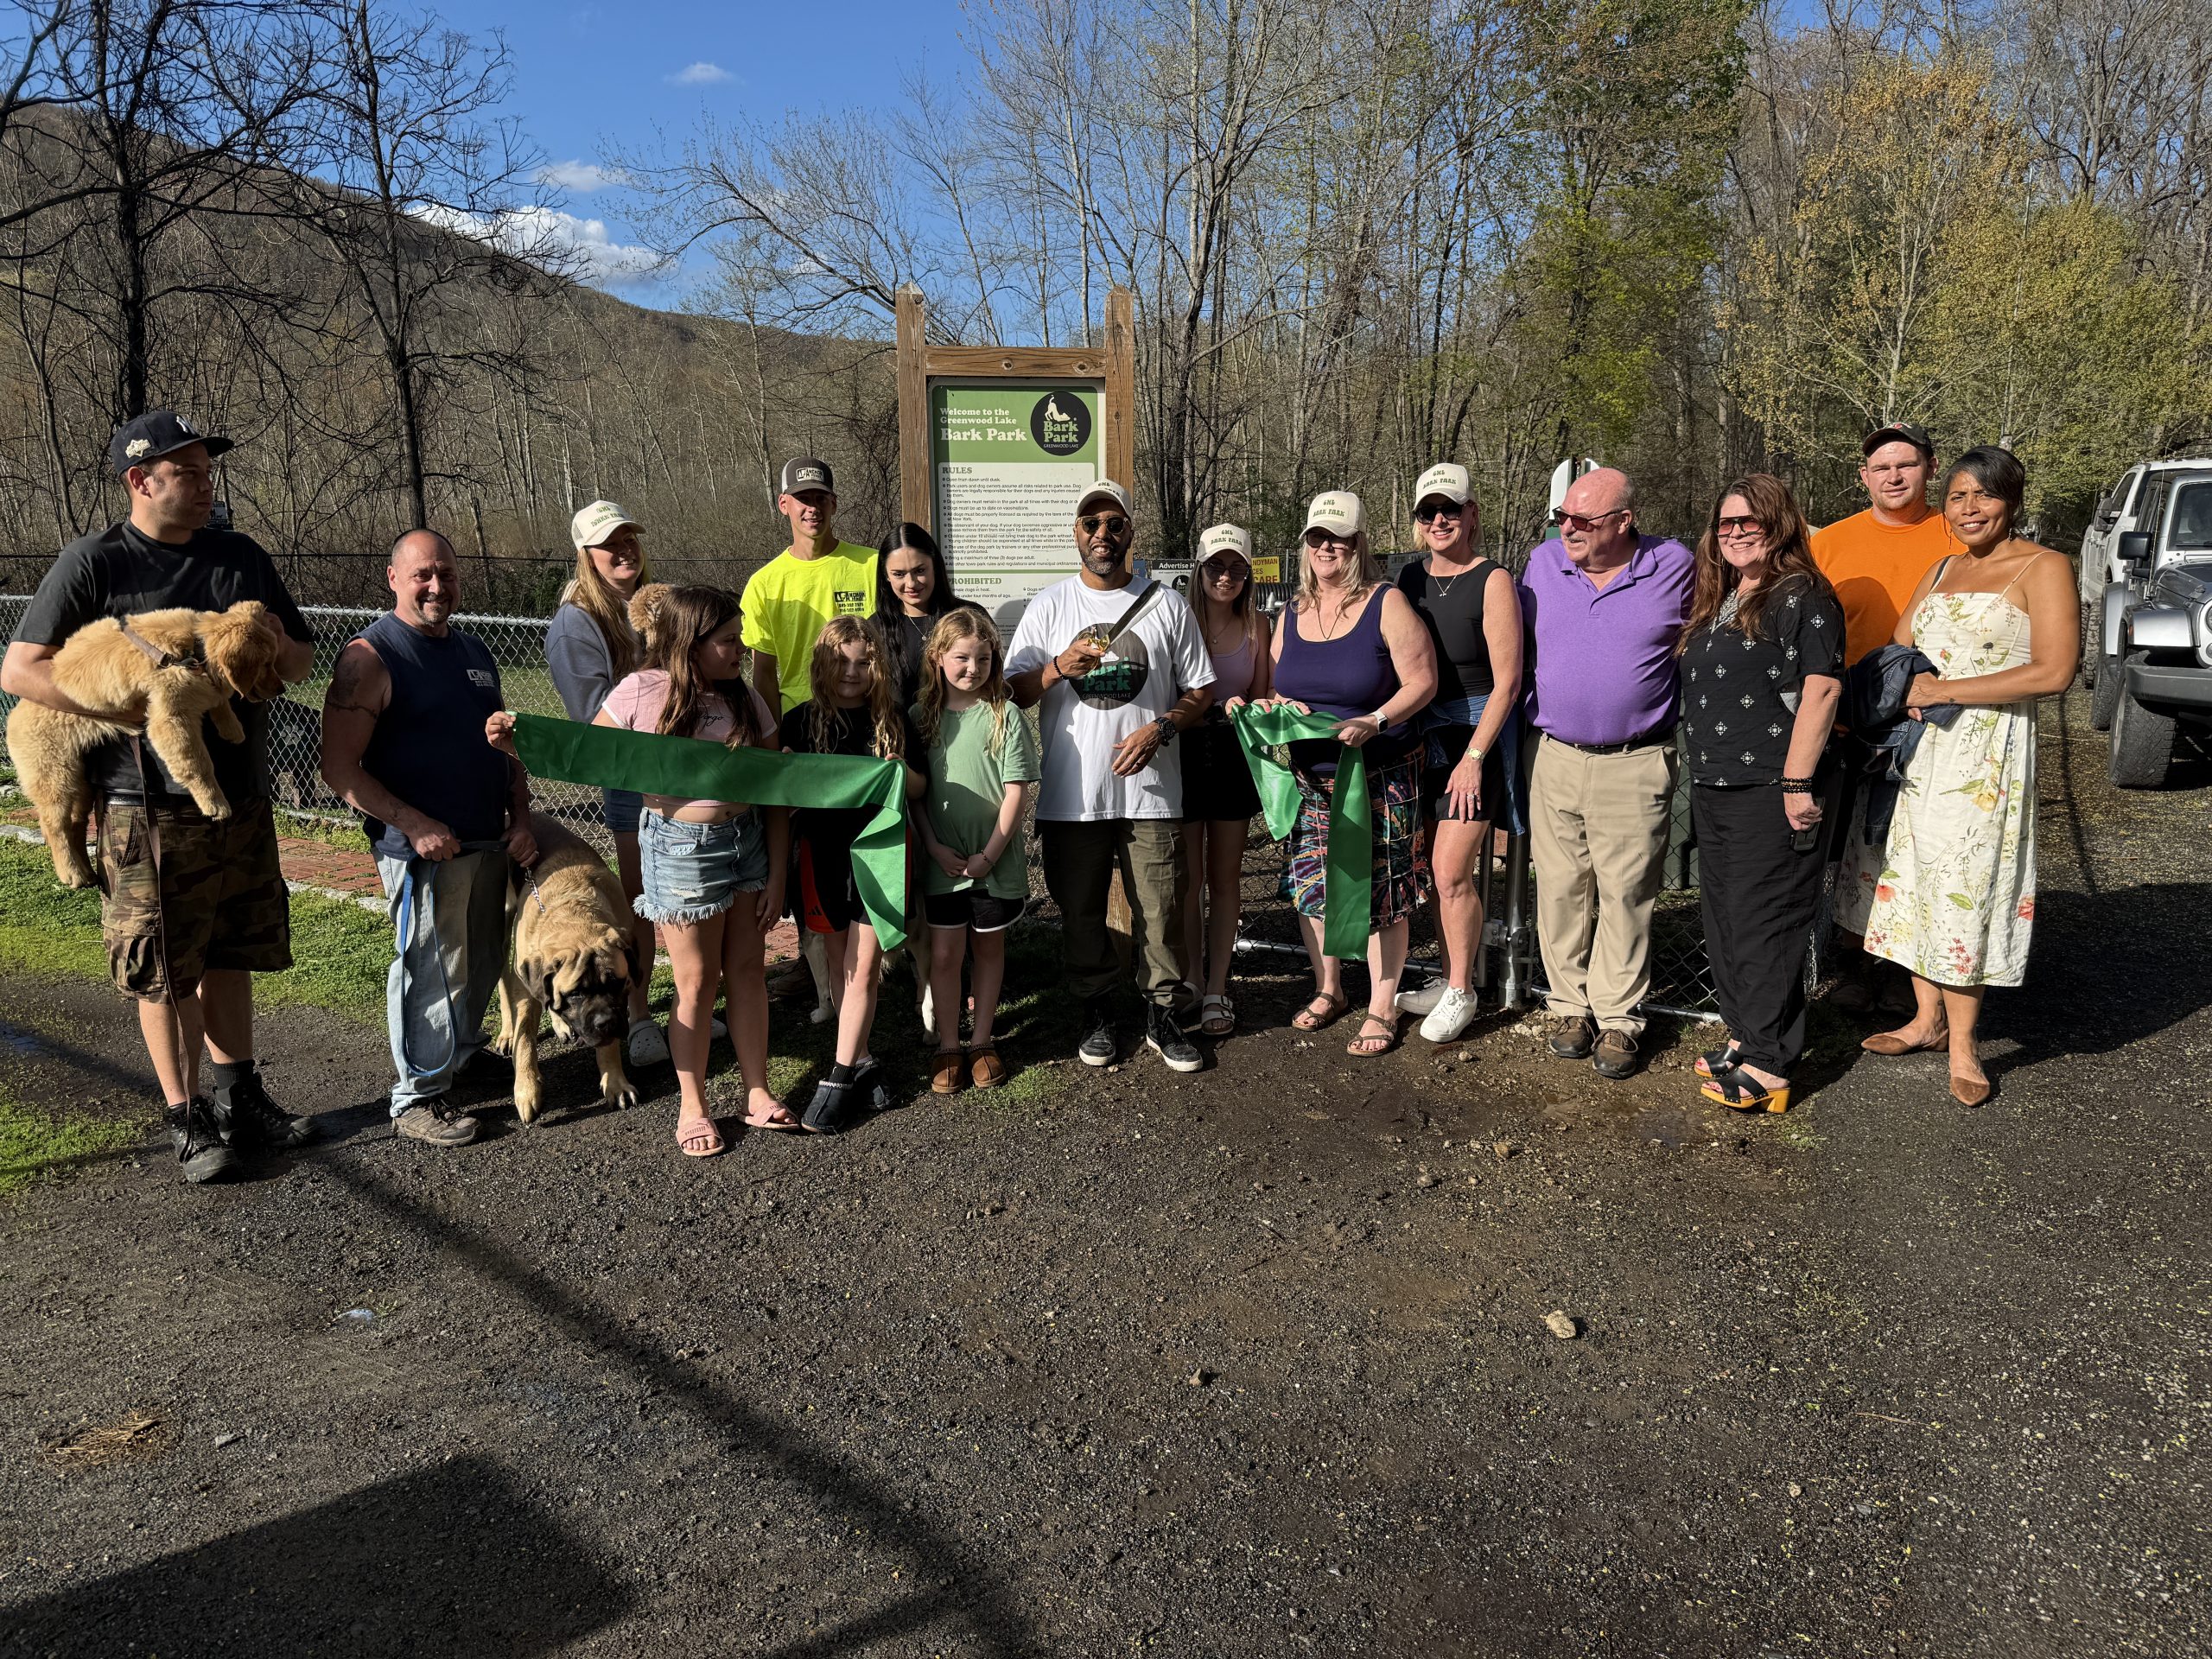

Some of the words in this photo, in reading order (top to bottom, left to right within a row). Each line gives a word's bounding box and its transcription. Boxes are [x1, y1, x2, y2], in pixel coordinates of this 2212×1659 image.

[1044, 421, 1078, 432] Bark
[940, 429, 982, 441] Bark
[987, 428, 1027, 441] Park
[1044, 432, 1078, 442] Park
[1229, 537, 1243, 546] PARK
[1086, 662, 1132, 677] ark
[1083, 677, 1131, 691] Park
